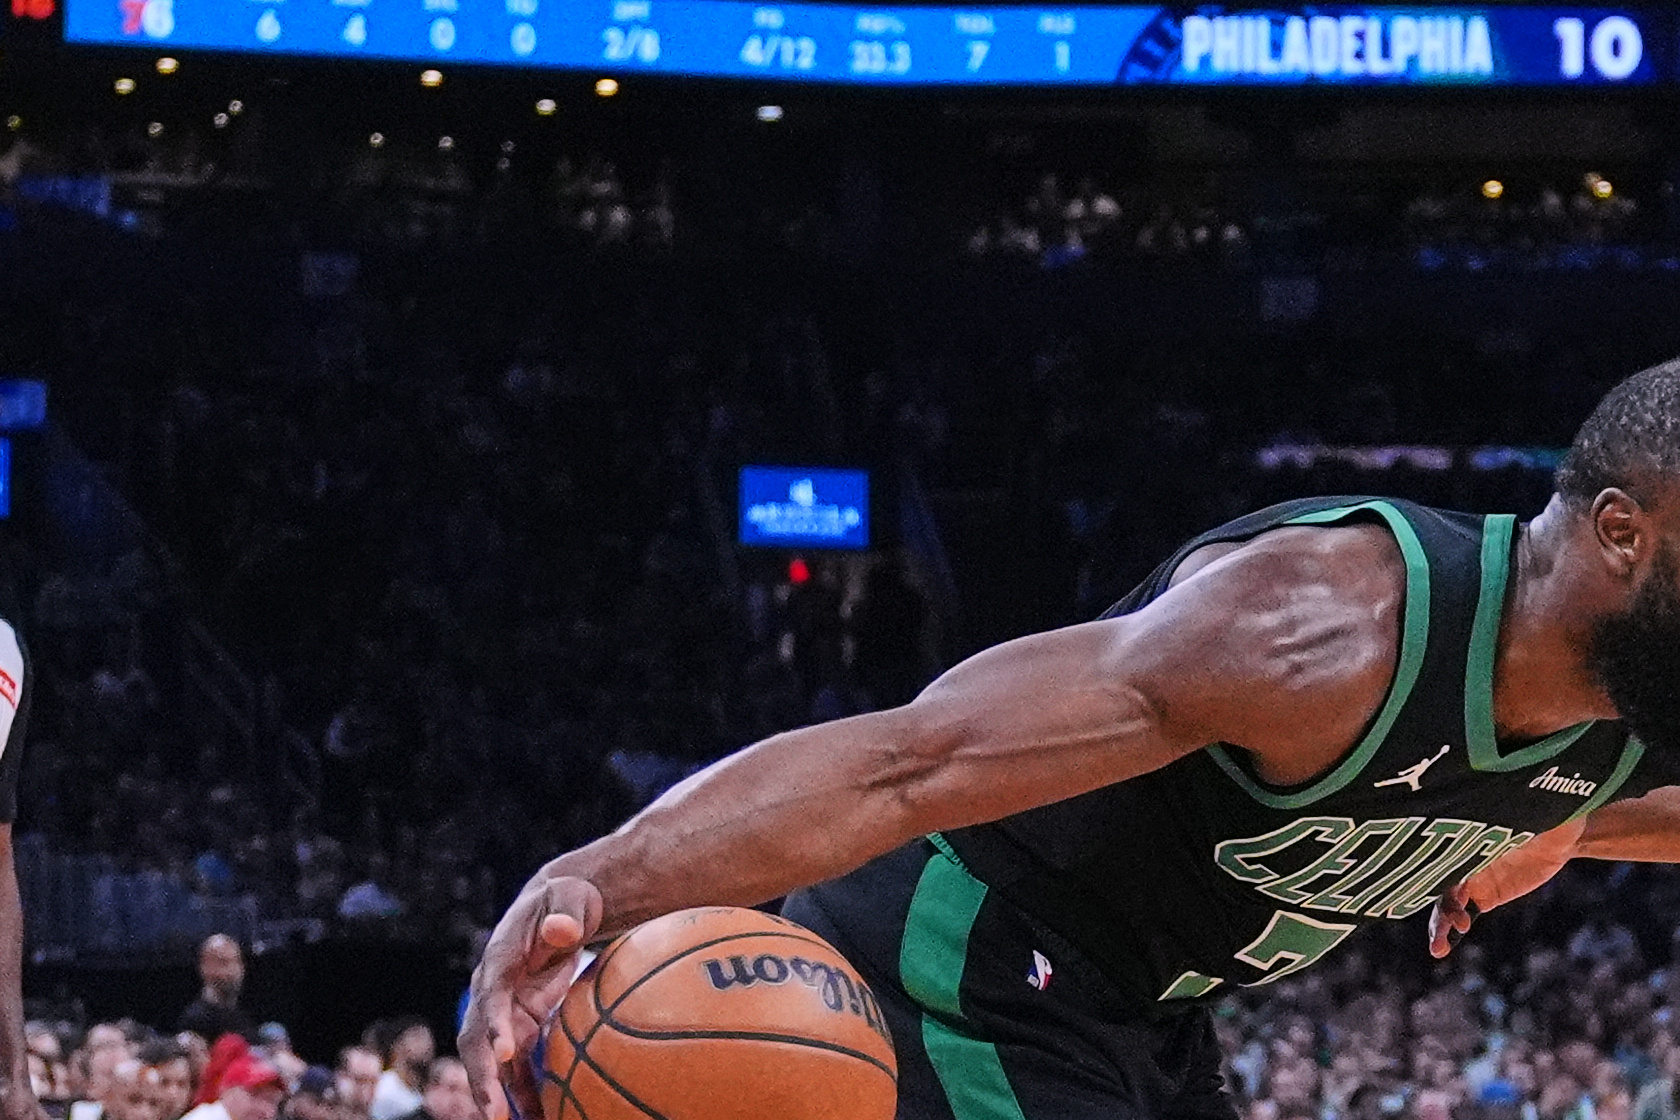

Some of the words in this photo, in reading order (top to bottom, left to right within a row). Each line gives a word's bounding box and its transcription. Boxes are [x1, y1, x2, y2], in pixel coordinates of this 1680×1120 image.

[430, 17, 456, 50] 0
[510, 22, 537, 56] 0
[967, 40, 990, 72] 7
[1182, 16, 1494, 75] PHILADELPHIA
[1553, 17, 1642, 78] 10
[1528, 765, 1597, 797] Amica
